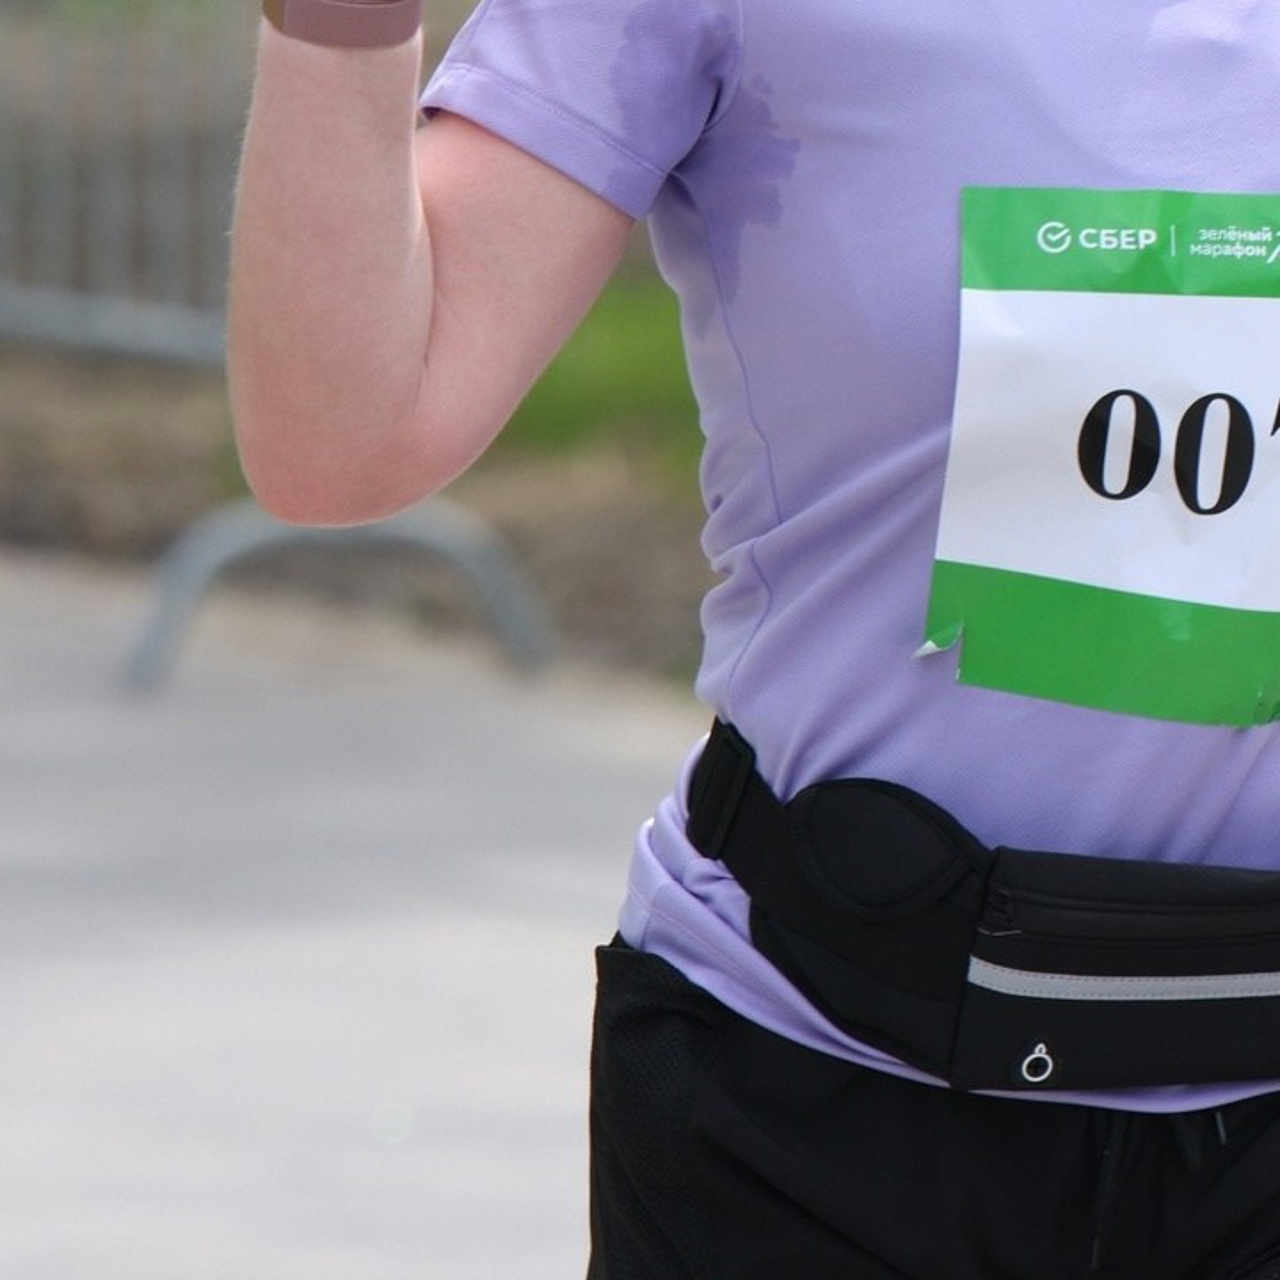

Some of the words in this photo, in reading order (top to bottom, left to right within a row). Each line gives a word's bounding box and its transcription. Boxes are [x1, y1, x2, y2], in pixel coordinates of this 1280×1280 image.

[1079, 228, 1157, 249] СБЕР
[1198, 225, 1273, 242] зелёный
[1189, 241, 1267, 259] марафон
